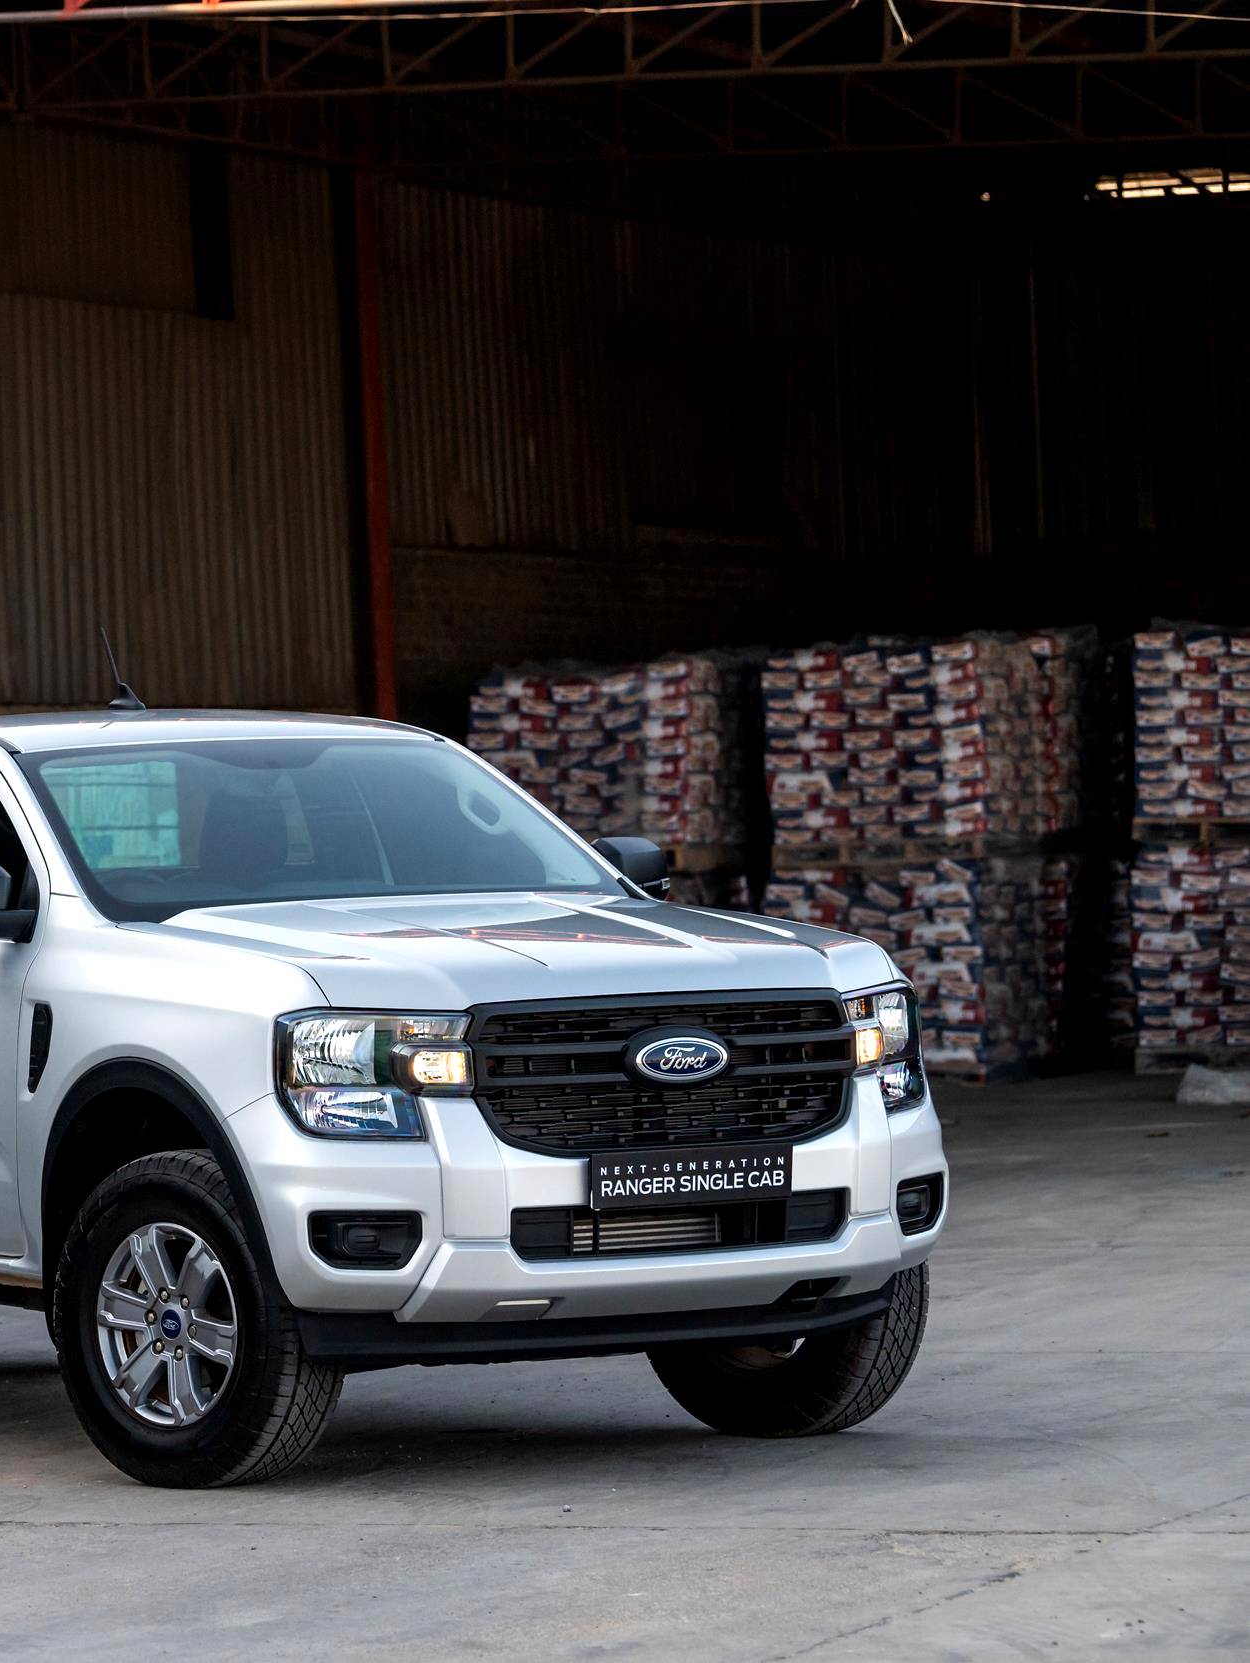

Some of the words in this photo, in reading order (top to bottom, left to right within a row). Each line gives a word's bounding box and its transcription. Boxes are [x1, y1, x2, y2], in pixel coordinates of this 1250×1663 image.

[659, 1046, 708, 1071] Ford
[600, 1156, 785, 1176] NEXT-GENERATION
[601, 1176, 676, 1197] RANGER
[679, 1172, 744, 1193] SINGLE
[747, 1169, 785, 1188] CAB
